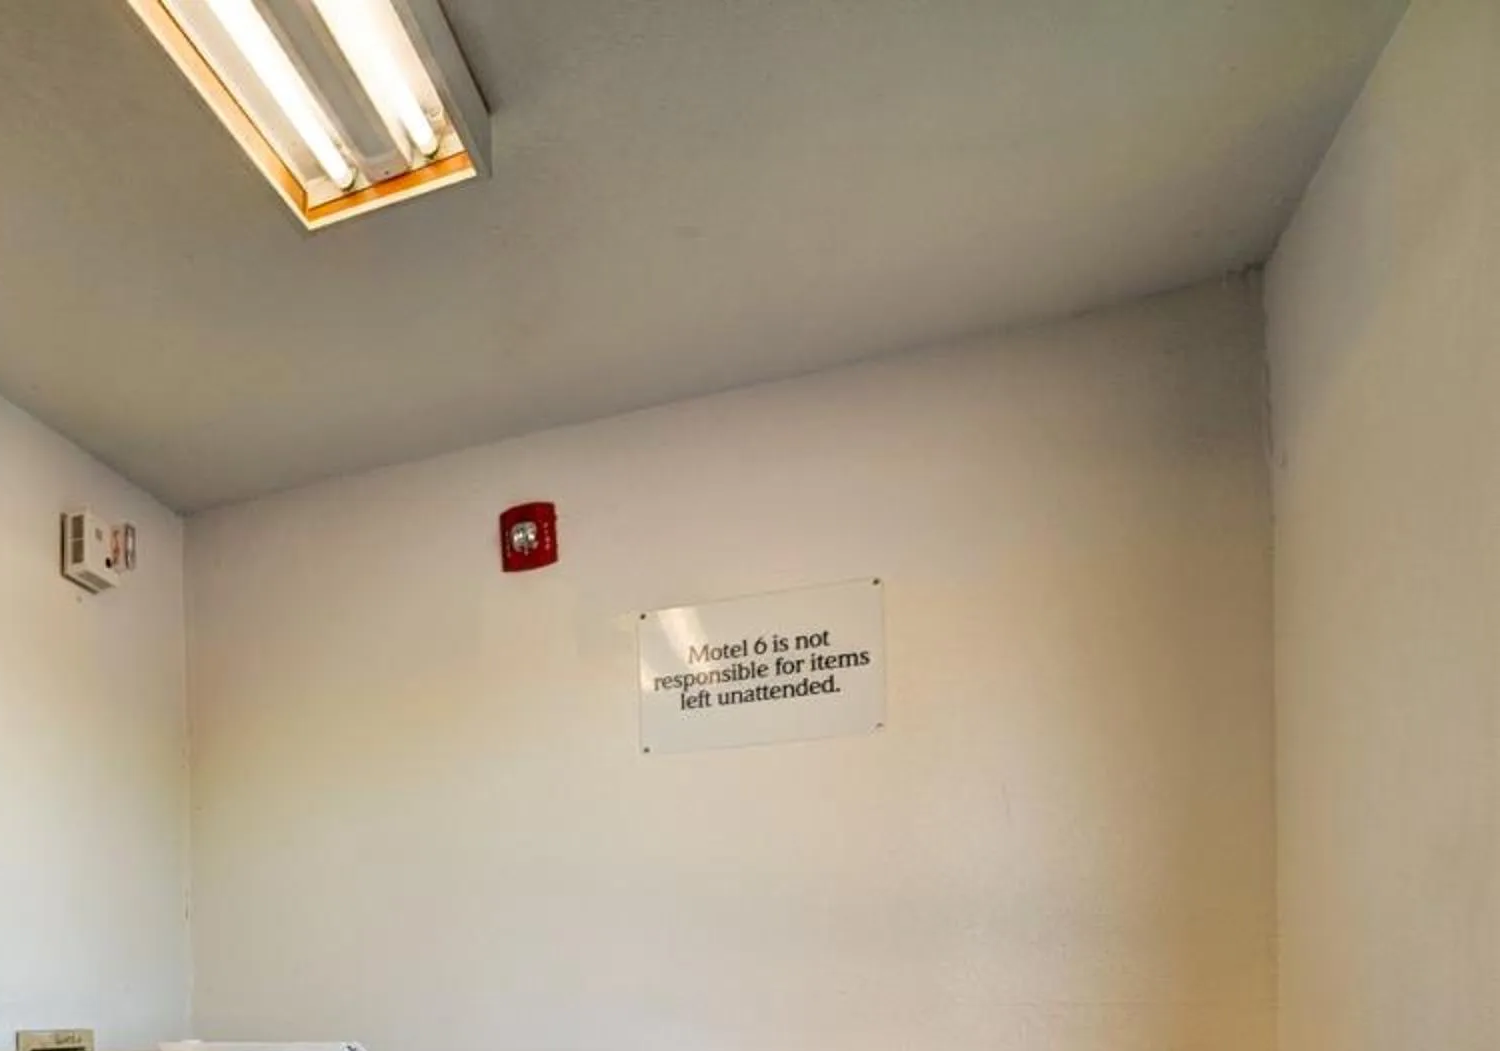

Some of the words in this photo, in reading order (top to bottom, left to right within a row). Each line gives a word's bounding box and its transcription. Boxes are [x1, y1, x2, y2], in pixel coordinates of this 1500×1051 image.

[688, 640, 747, 664] Motel
[754, 637, 767, 655] 6
[773, 634, 789, 652] is
[795, 630, 830, 650] not
[654, 663, 769, 692] responsible
[775, 656, 805, 676] for
[811, 650, 870, 672] items
[680, 693, 711, 711] left
[718, 675, 841, 706] unattended.
